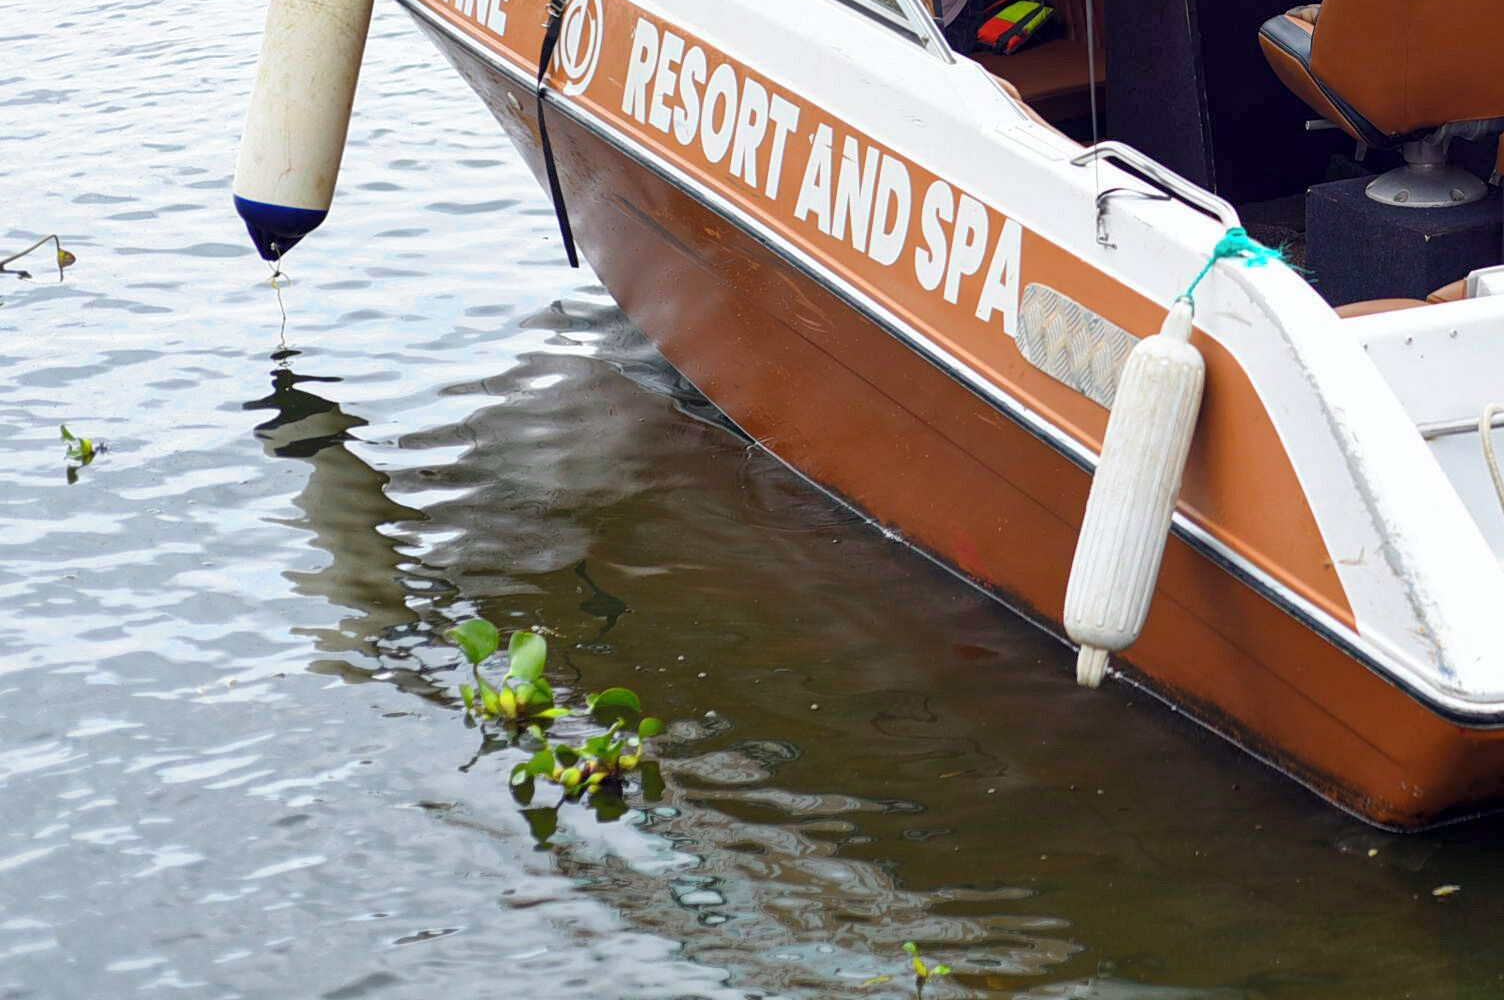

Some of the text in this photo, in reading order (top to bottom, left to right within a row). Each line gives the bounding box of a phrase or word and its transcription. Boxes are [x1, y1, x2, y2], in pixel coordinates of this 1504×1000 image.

[621, 17, 800, 200] RESORT
[793, 122, 912, 266] AND
[915, 180, 1023, 339] SPA
